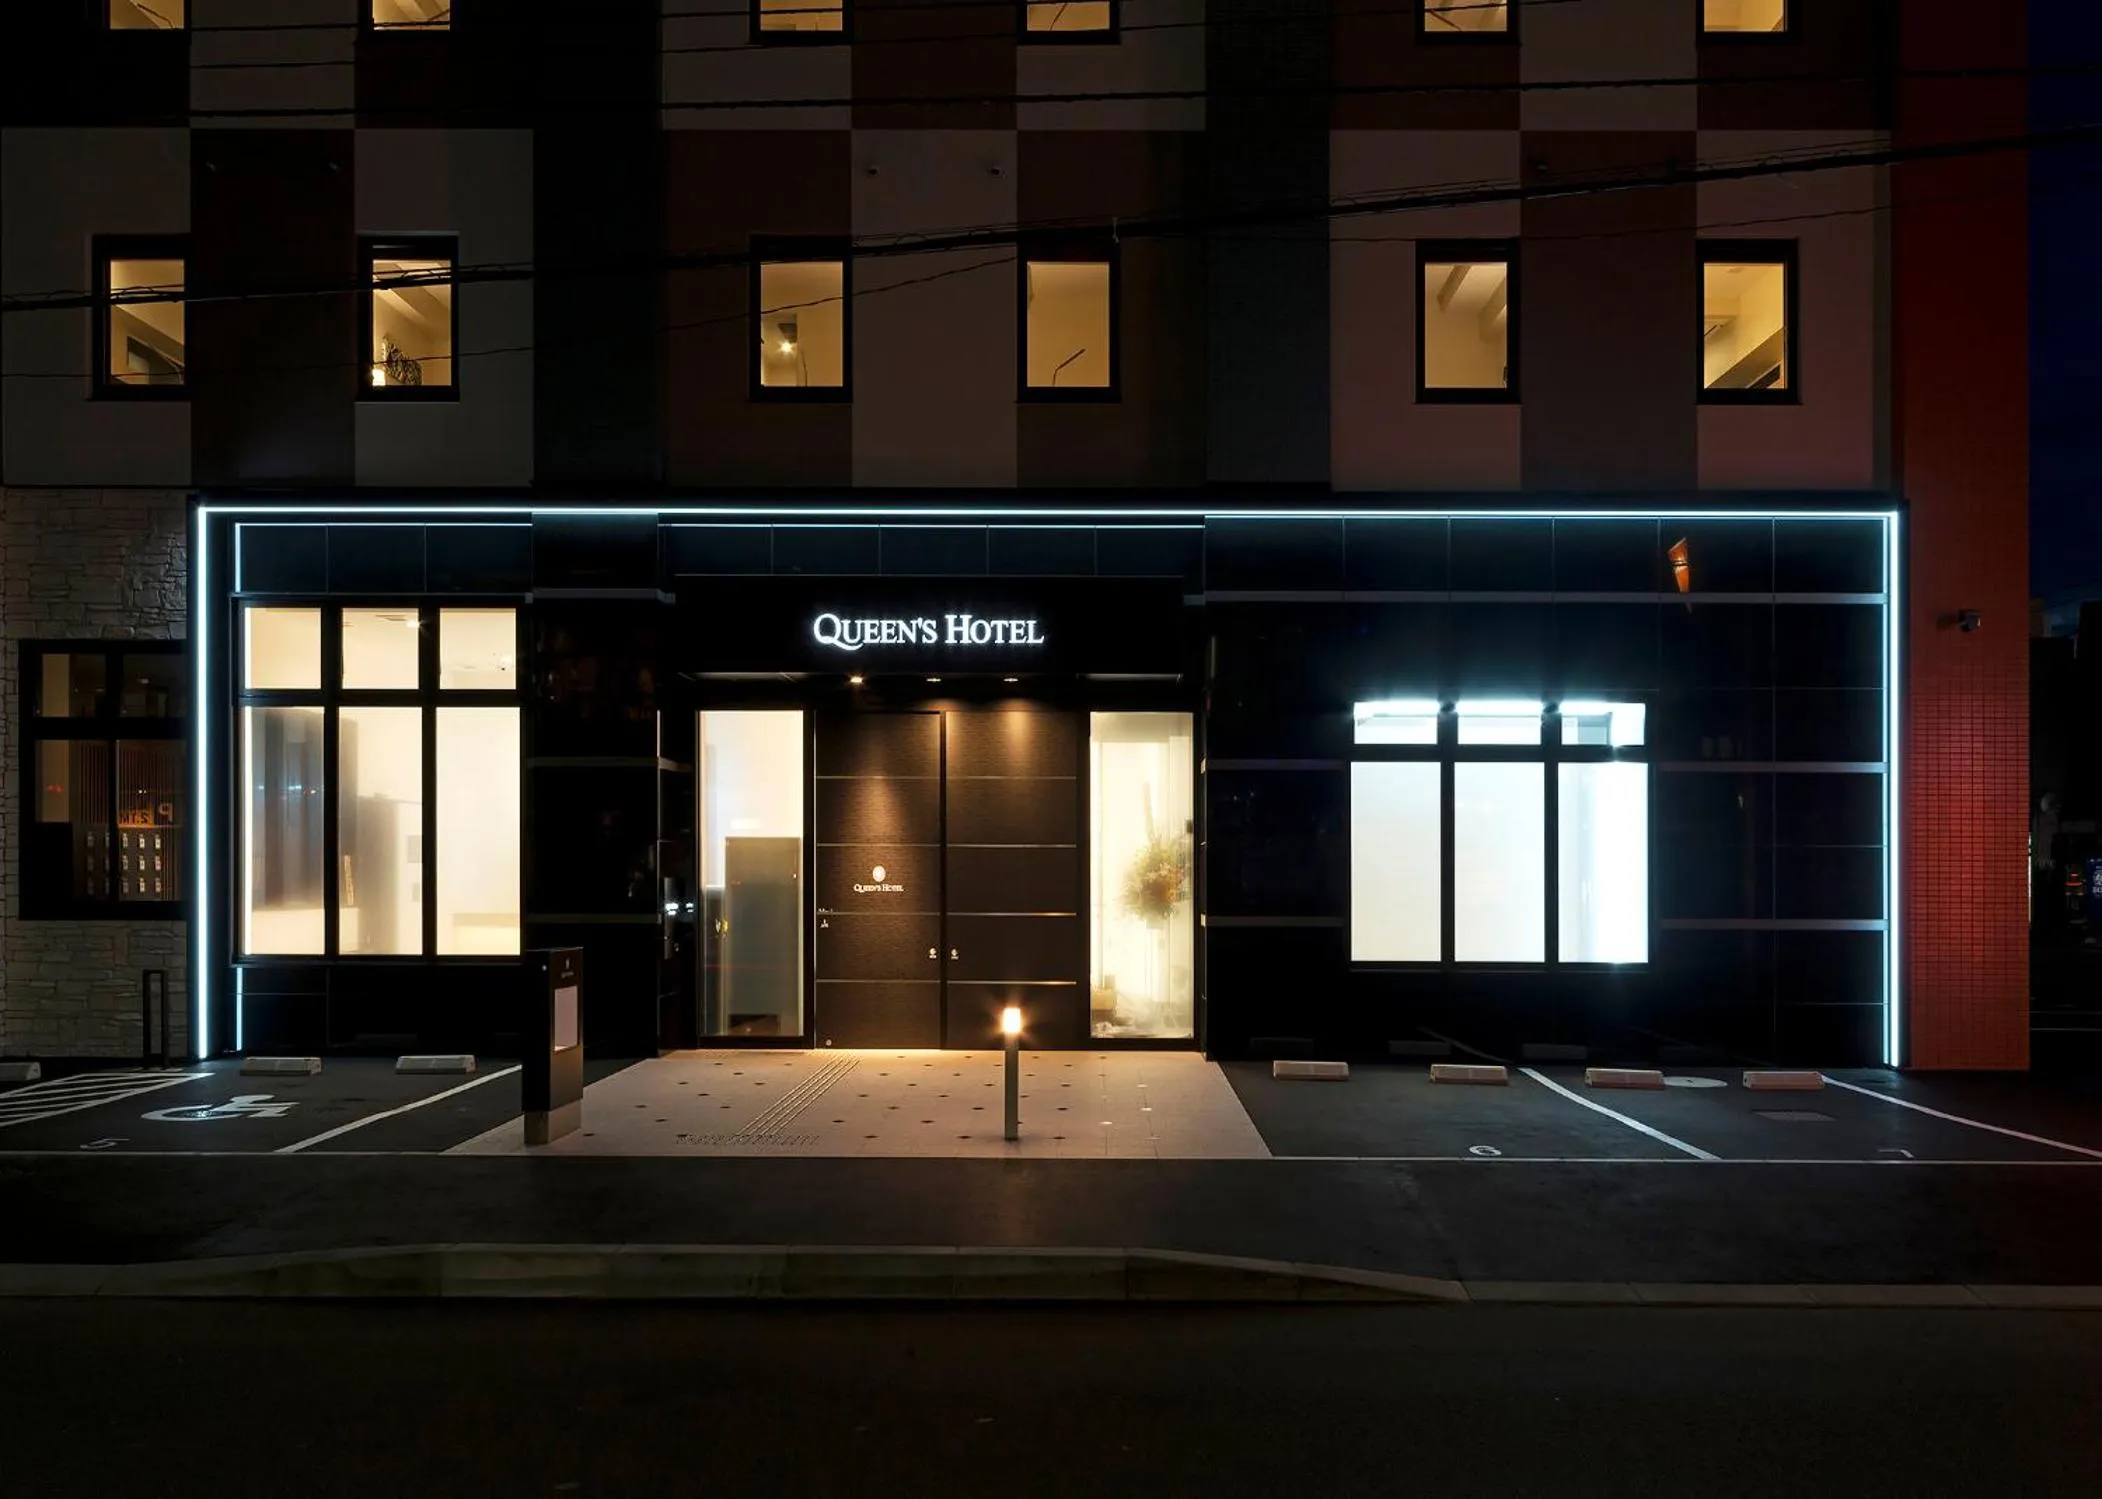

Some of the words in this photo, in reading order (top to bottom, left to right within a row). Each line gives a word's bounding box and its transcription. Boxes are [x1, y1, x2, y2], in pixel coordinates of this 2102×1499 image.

[813, 613, 938, 651] QUEEN'S
[944, 614, 1045, 644] HOTEL
[1468, 1145, 1502, 1157] 6
